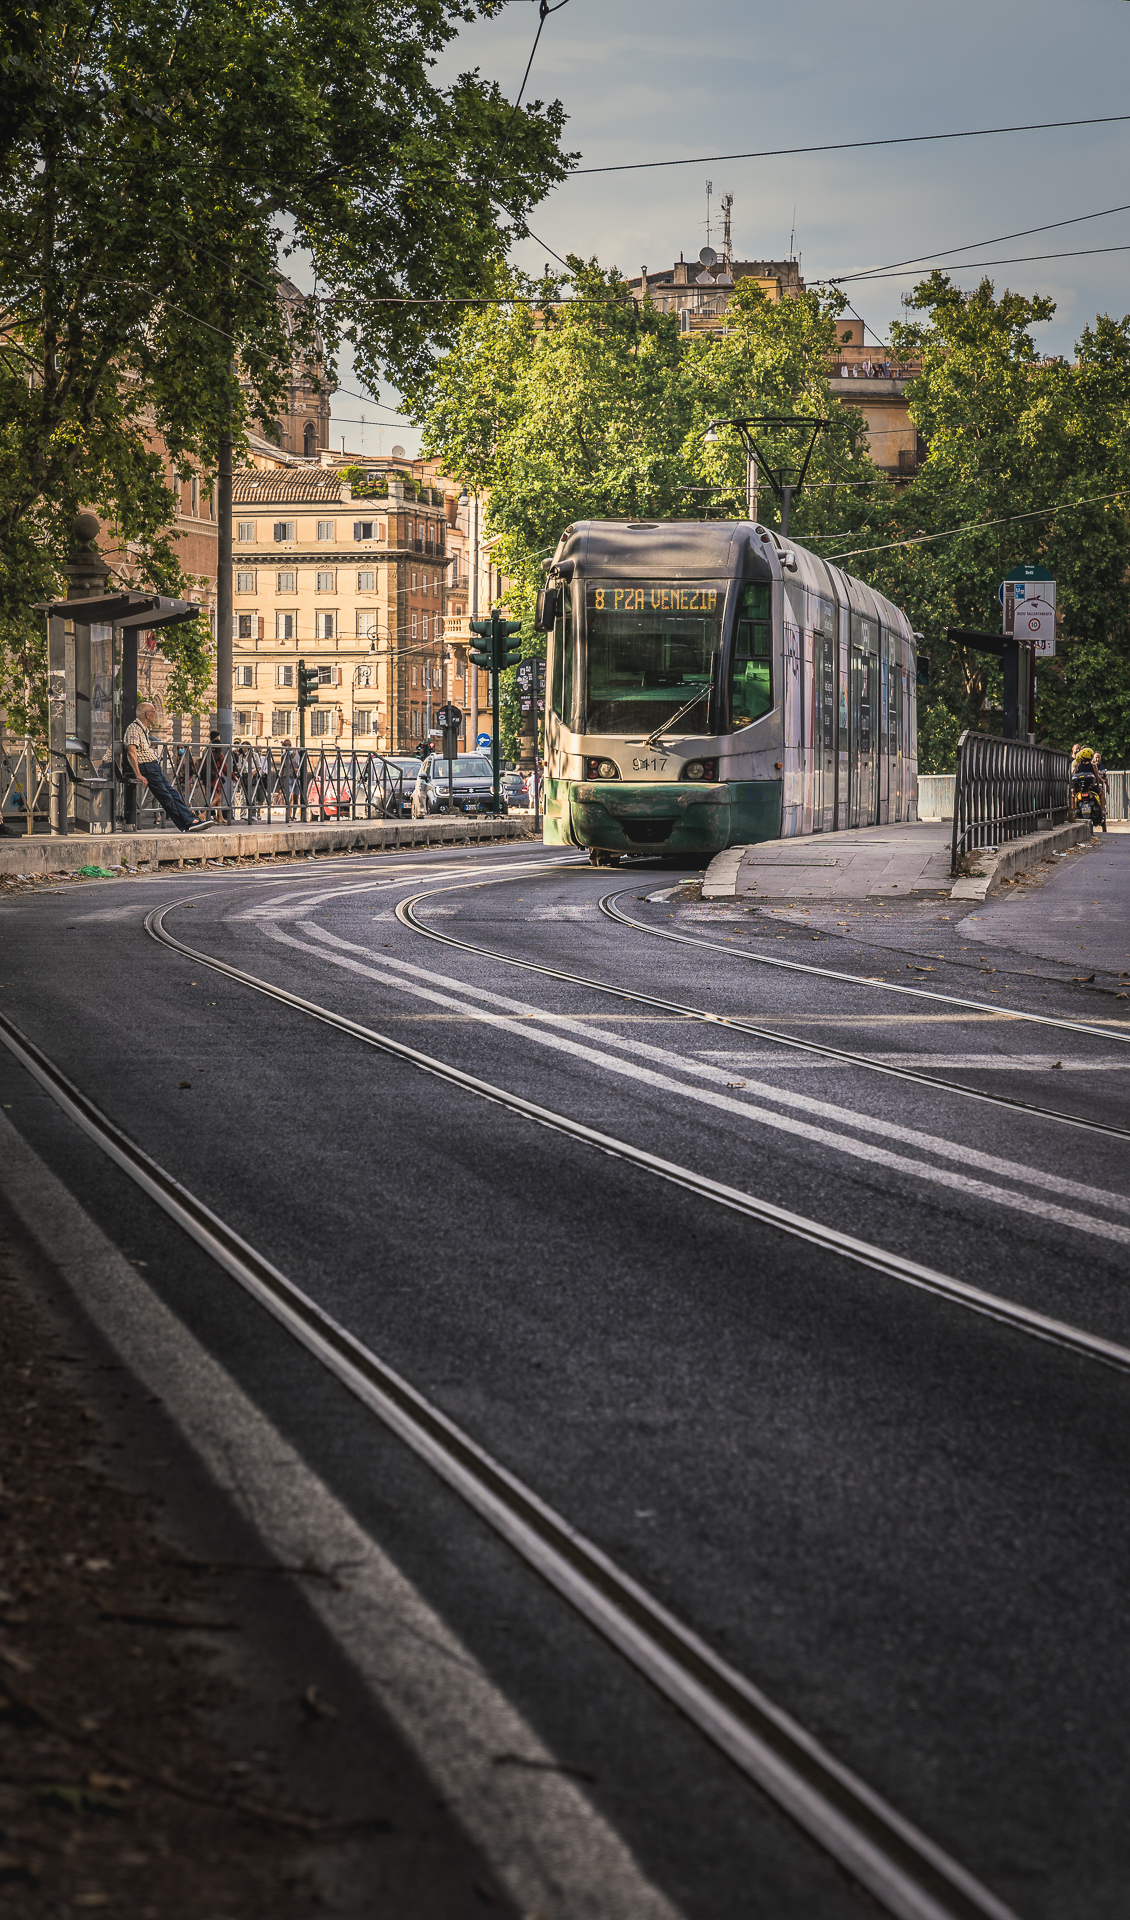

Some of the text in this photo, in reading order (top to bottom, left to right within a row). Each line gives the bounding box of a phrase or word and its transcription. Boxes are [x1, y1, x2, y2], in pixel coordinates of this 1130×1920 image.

[595, 588, 717, 610] 8 PZA VENEZIA
[632, 757, 668, 771] 9117
